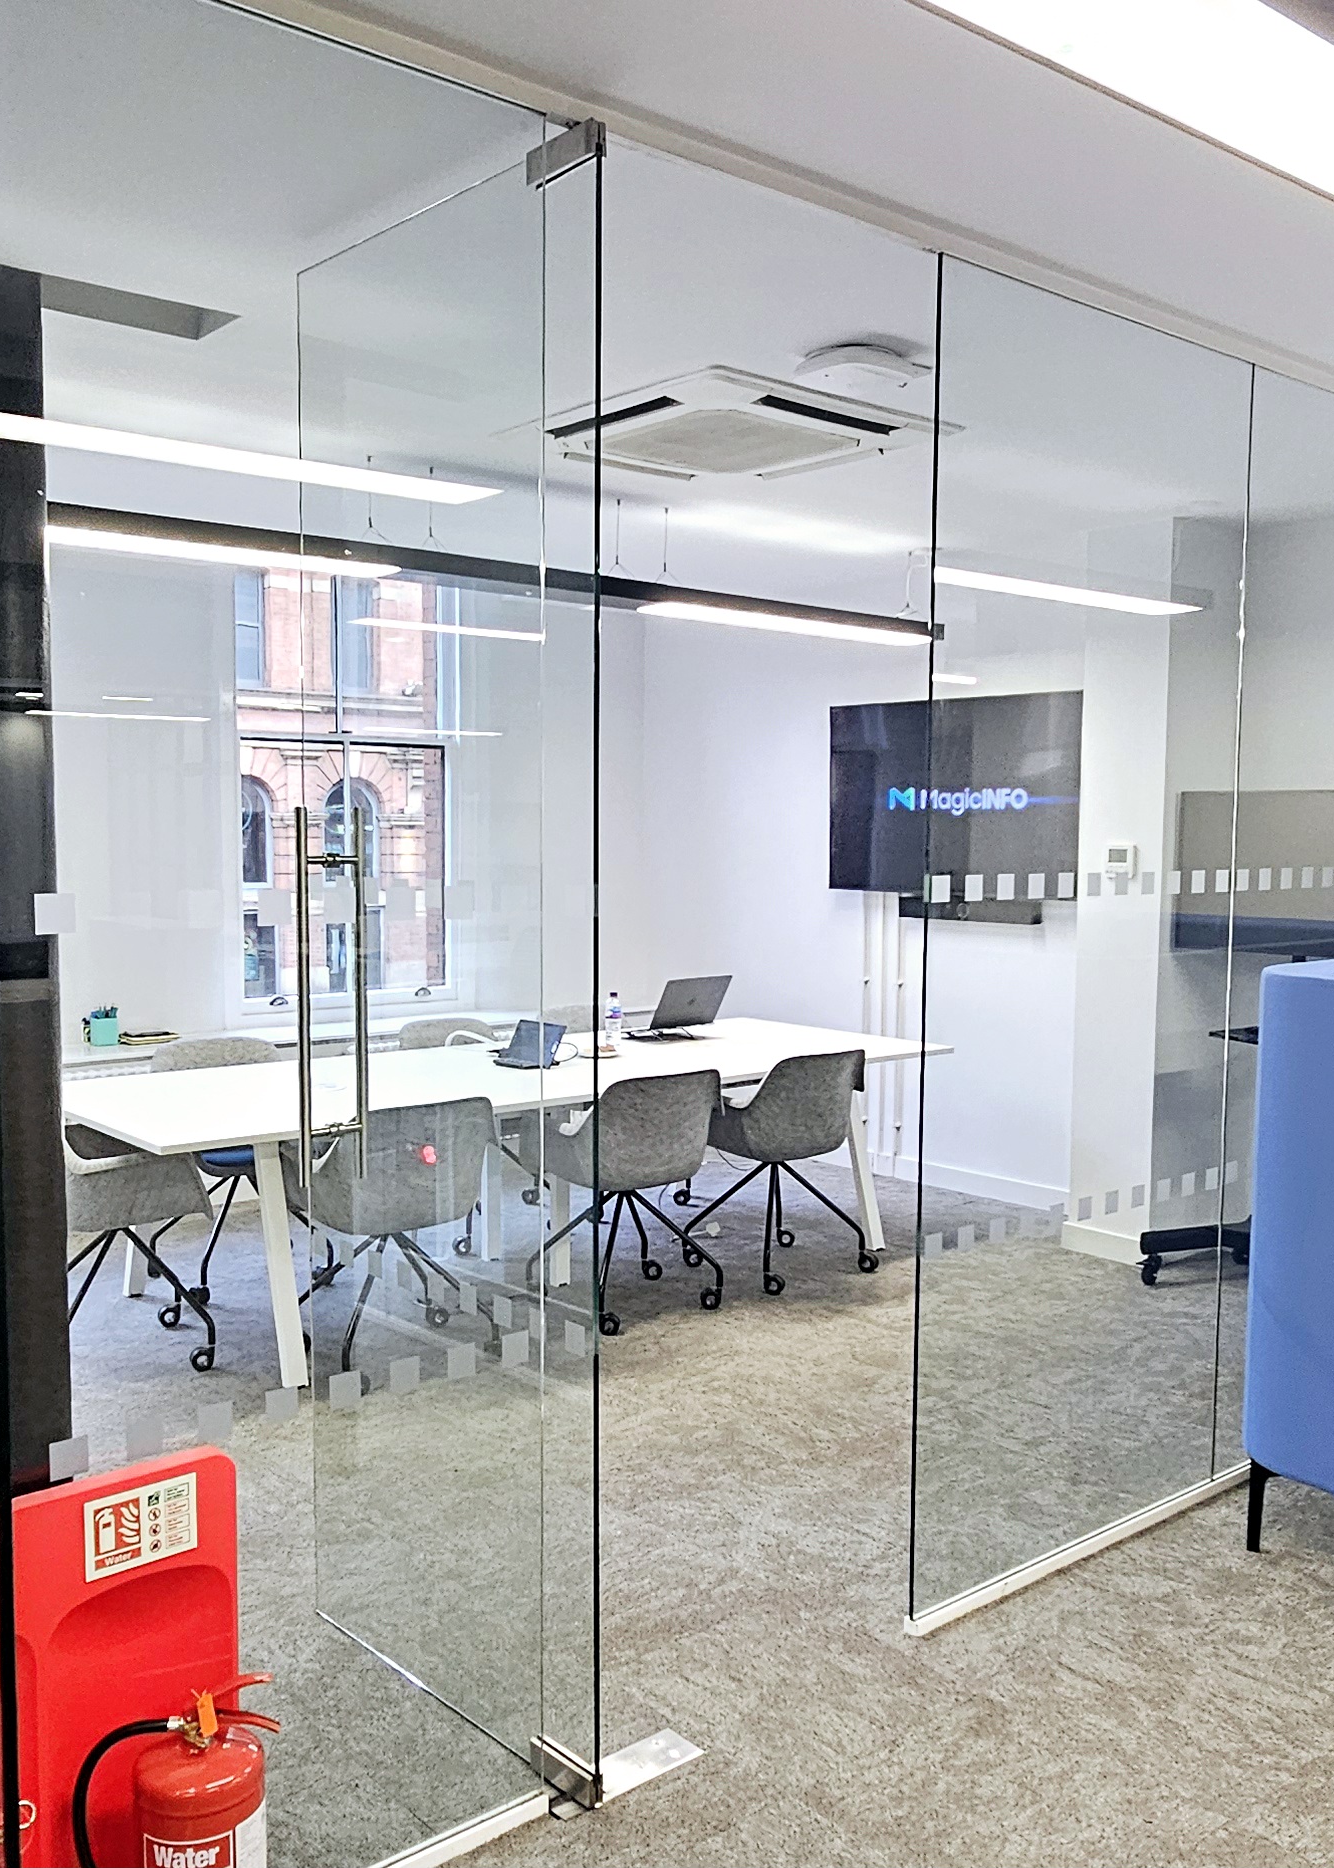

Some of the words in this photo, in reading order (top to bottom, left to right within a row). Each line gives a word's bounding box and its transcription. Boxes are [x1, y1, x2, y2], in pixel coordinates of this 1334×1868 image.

[919, 787, 1029, 816] MagicINFO
[104, 1551, 134, 1567] Water
[153, 1844, 221, 1868] Water
